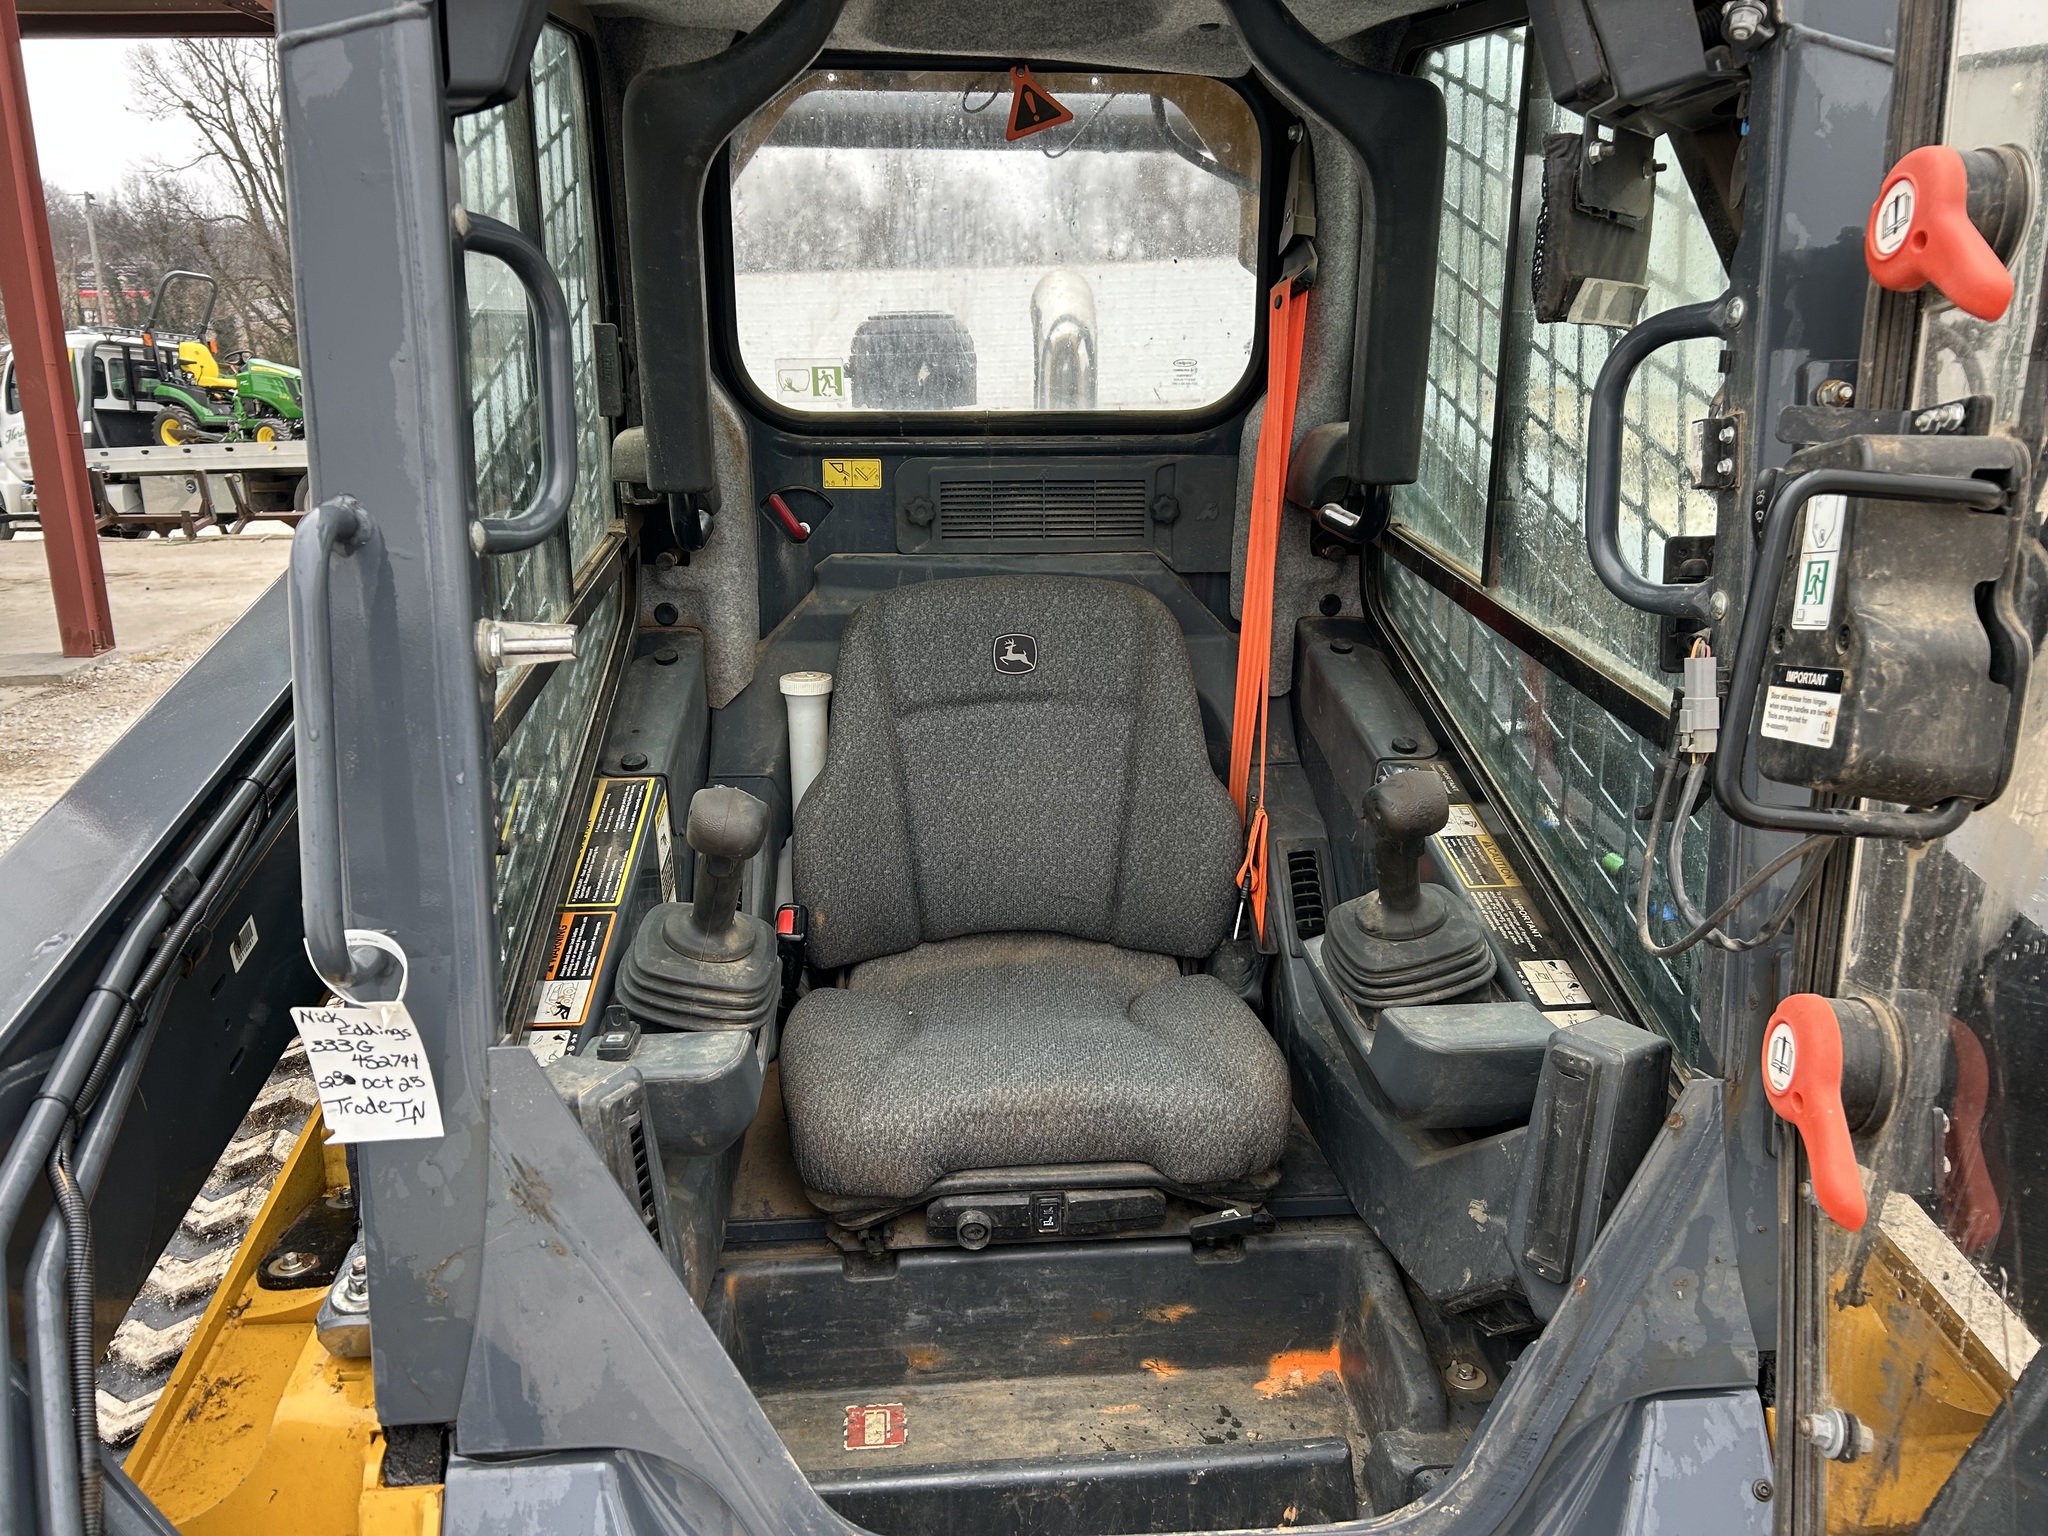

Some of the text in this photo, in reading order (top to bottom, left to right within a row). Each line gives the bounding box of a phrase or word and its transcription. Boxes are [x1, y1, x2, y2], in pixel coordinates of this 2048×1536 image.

[1785, 670, 1829, 686] IMPORTANT
[1487, 846, 1515, 879] CAUTION
[1511, 898, 1543, 938] IMPORTANT
[300, 1010, 349, 1027] Nick
[337, 1022, 412, 1040] Eddings
[399, 1075, 426, 1092] 25
[323, 1096, 392, 1114] Trade
